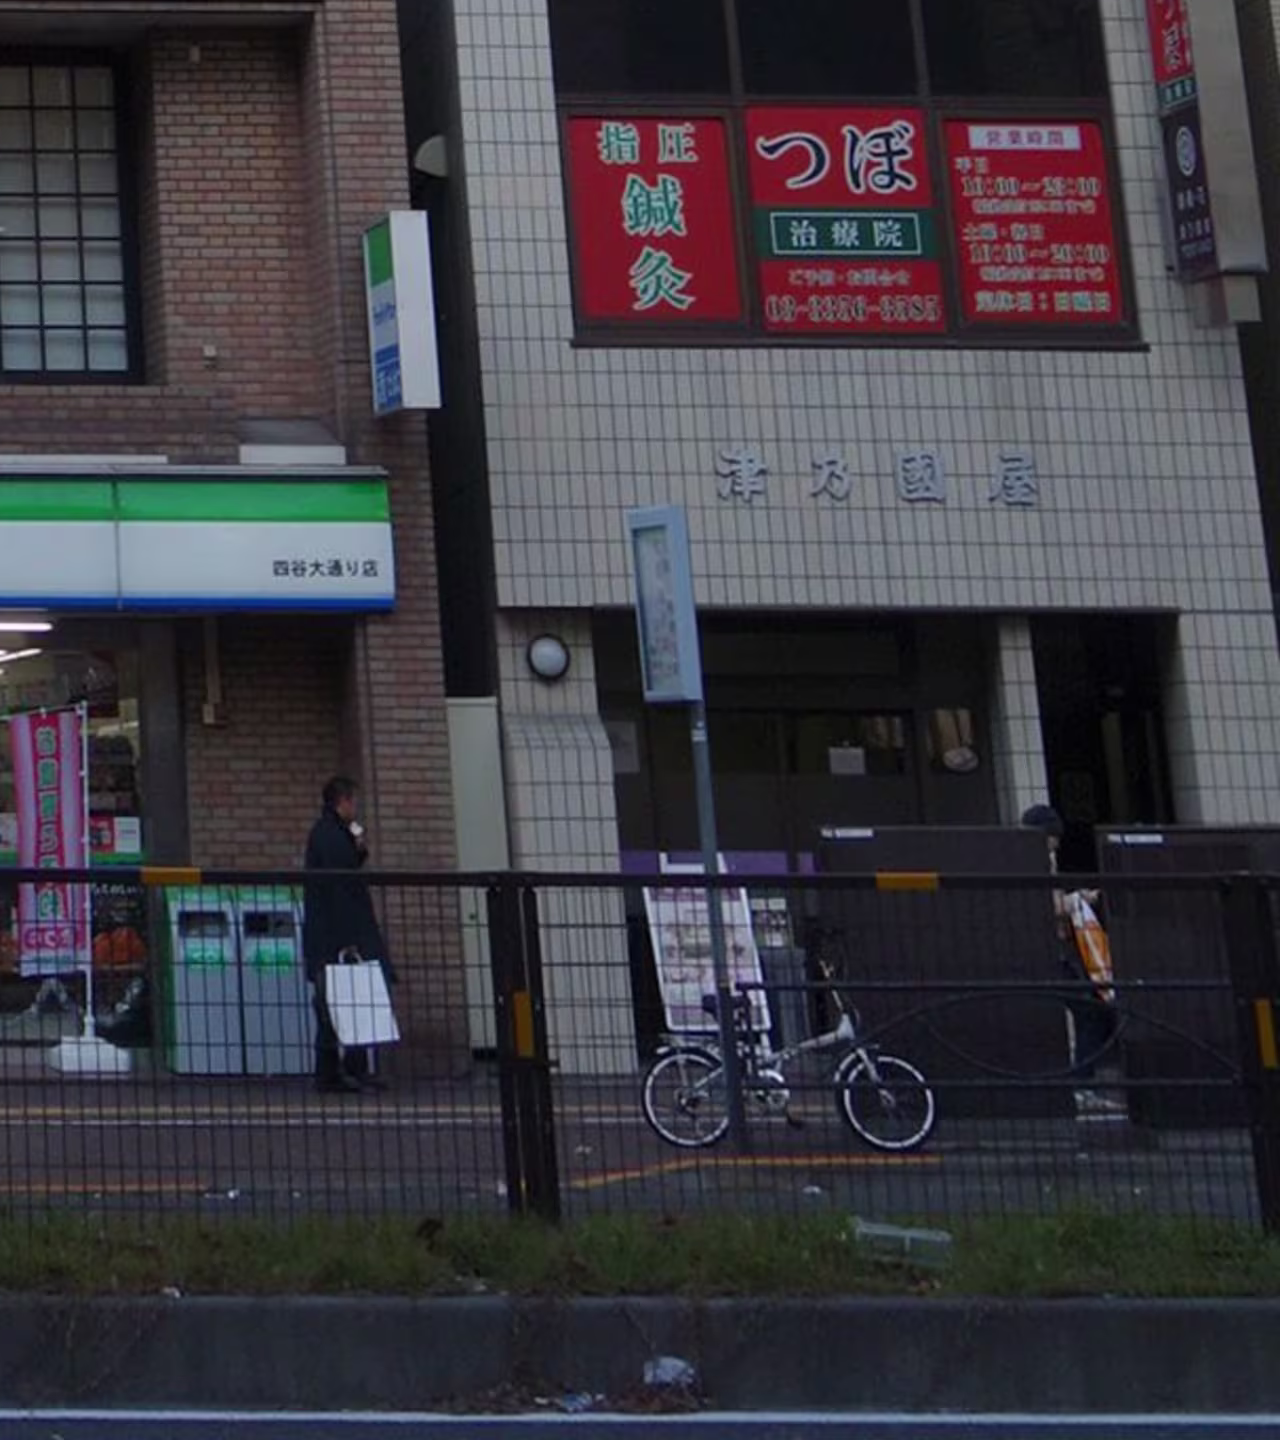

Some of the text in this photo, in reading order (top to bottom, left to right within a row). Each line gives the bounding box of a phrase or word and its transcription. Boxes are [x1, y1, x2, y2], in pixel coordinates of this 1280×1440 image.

[597, 122, 698, 164] 指圧
[985, 130, 1064, 146] 営業時間
[758, 120, 919, 194] つぼ
[621, 173, 696, 311] 鍼灸
[789, 219, 904, 248] 治療院
[272, 558, 380, 579] 四谷大通り店
